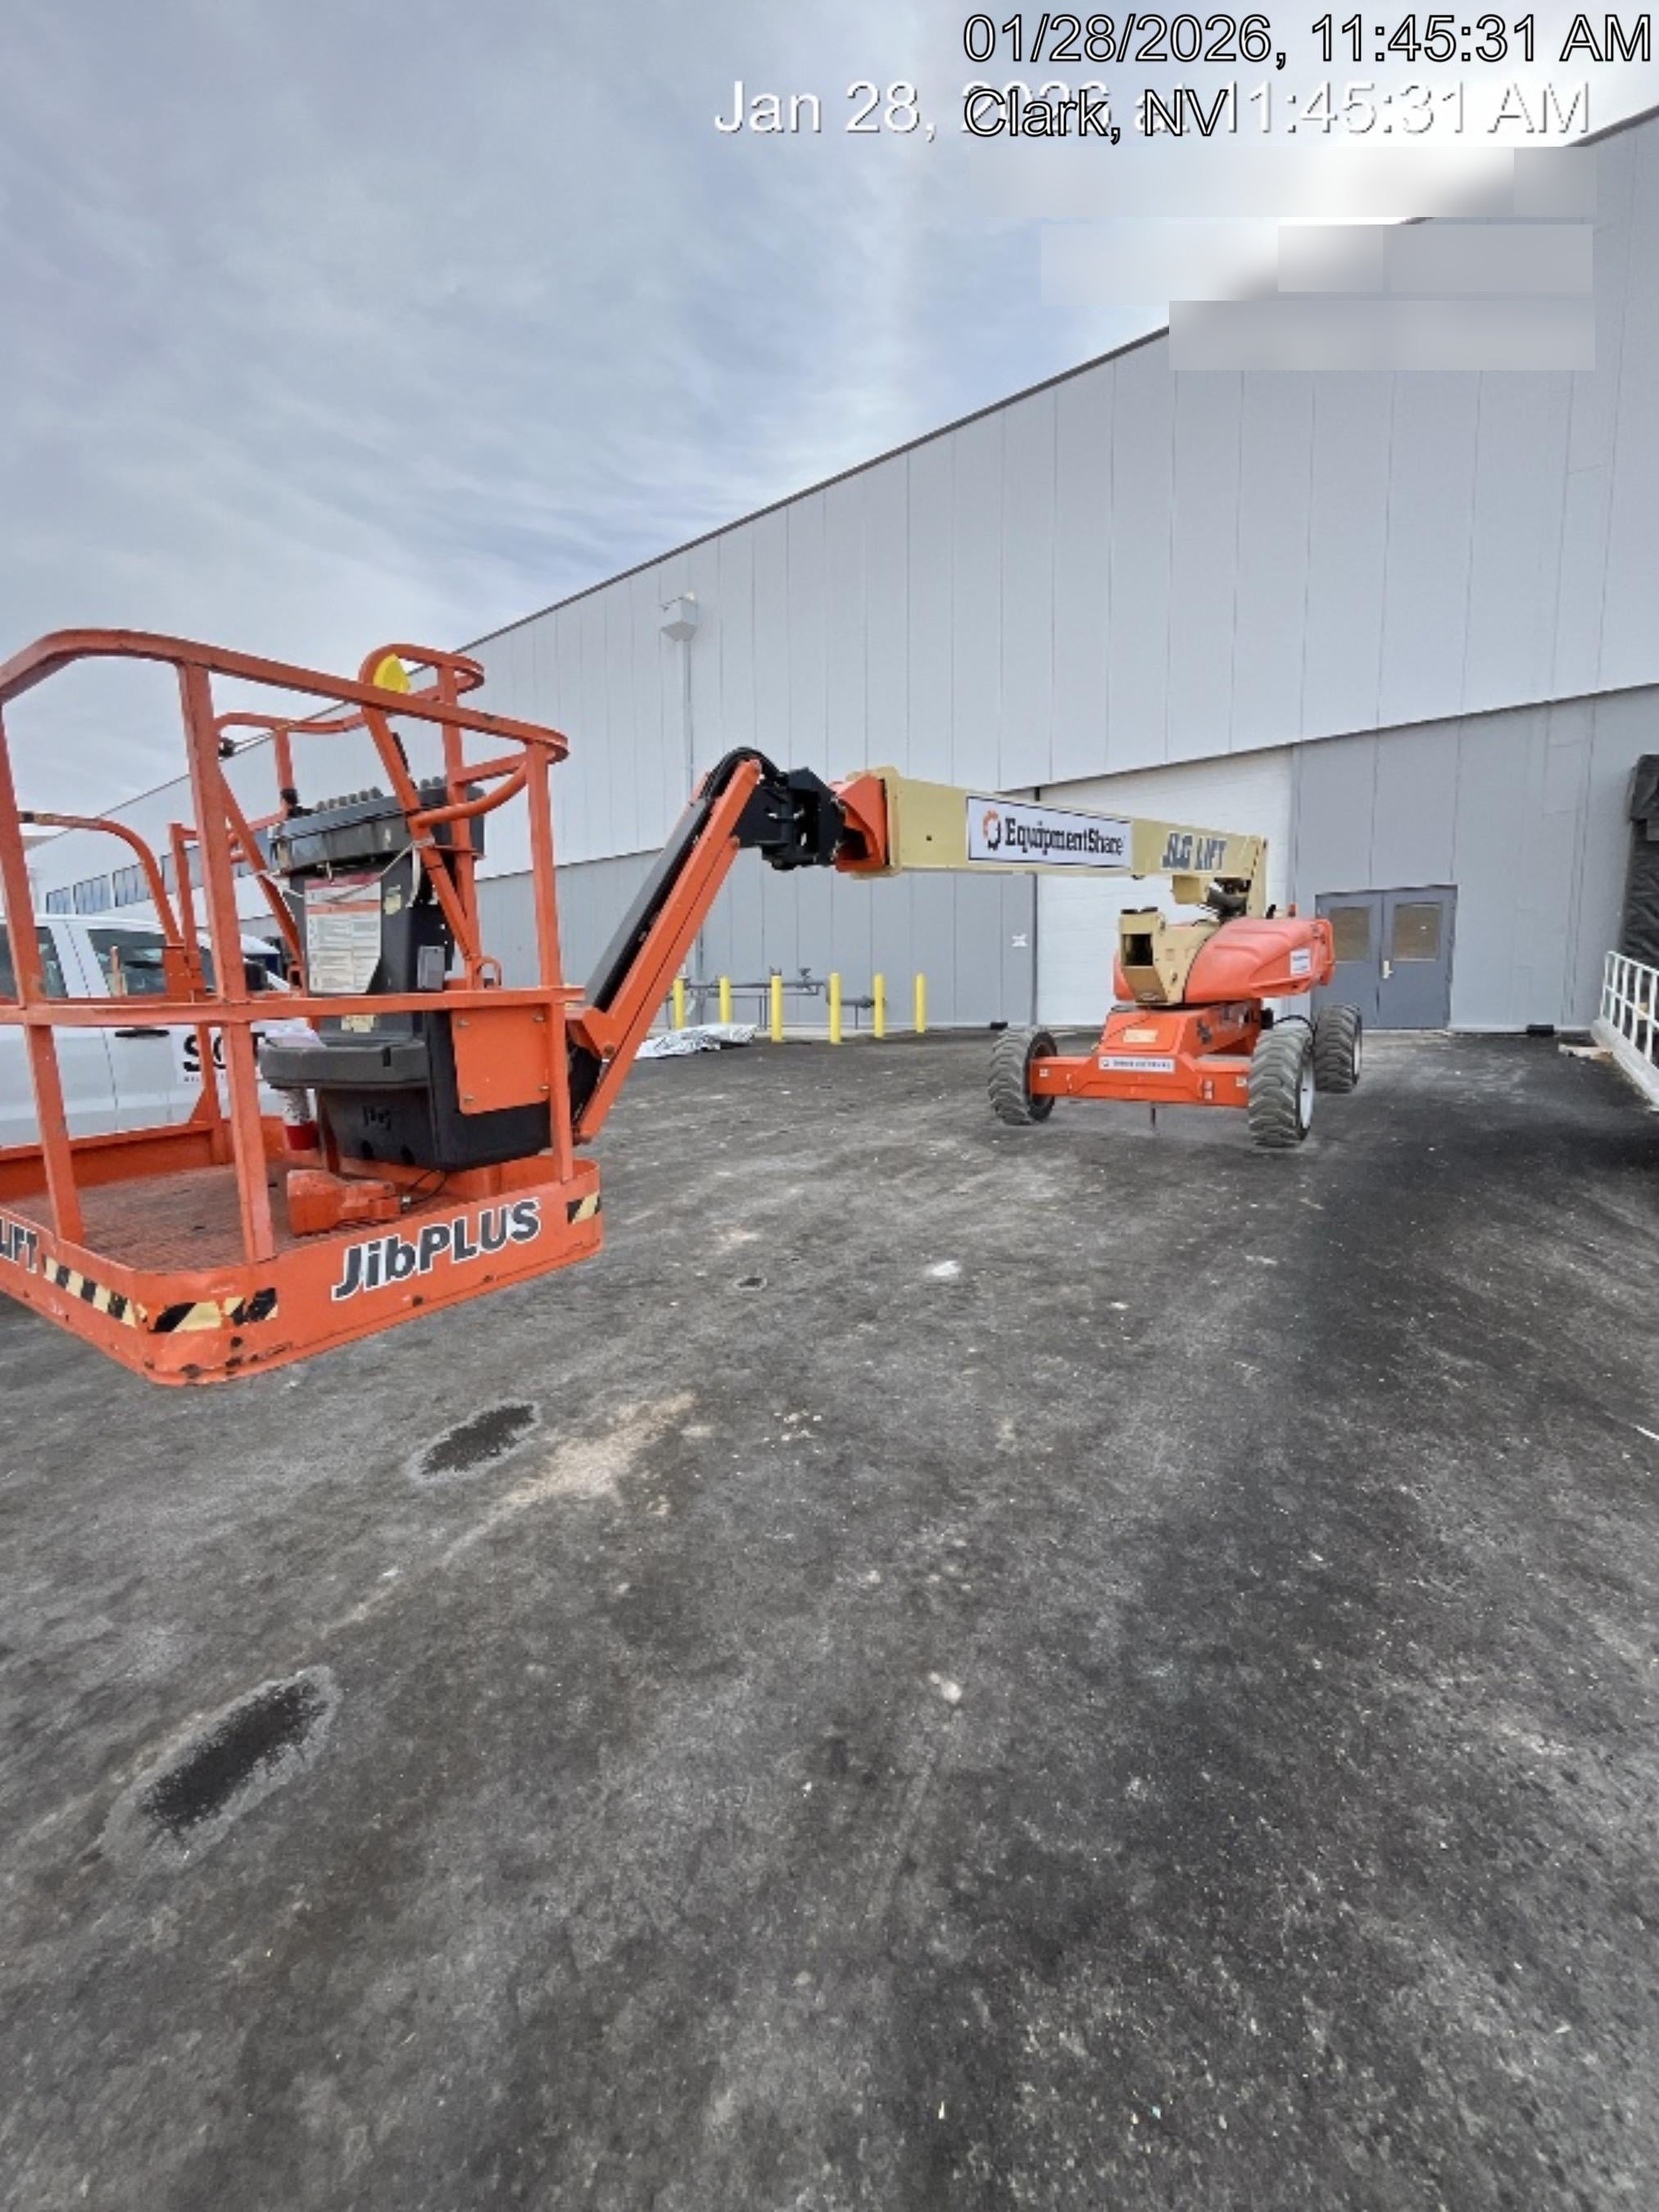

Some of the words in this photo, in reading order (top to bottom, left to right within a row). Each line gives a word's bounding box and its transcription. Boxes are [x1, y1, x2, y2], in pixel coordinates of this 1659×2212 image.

[1004, 817, 1124, 855] EquipmentShare
[1194, 836, 1227, 871] LIFT
[332, 1197, 542, 1301] JibPLUS
